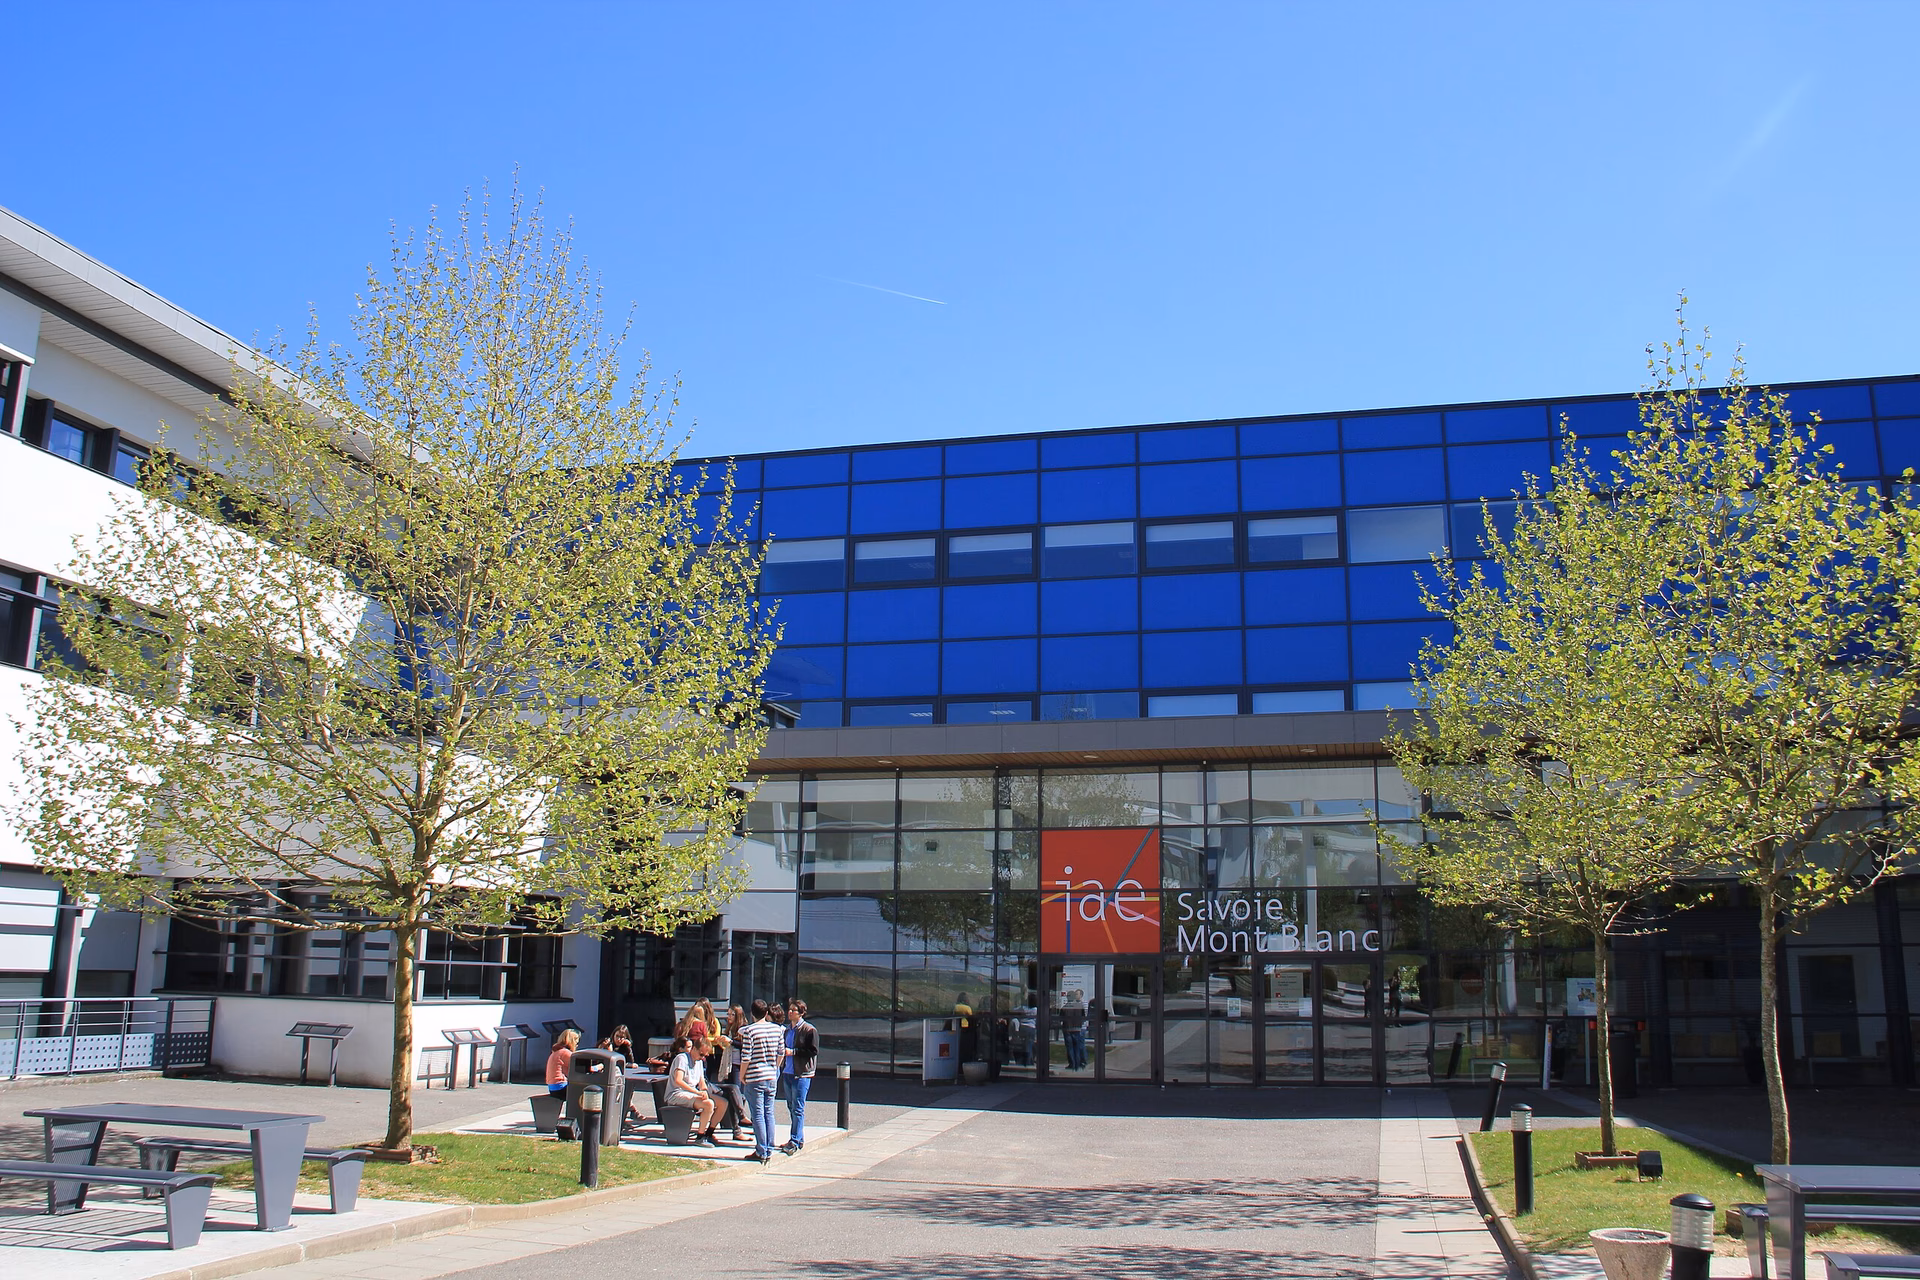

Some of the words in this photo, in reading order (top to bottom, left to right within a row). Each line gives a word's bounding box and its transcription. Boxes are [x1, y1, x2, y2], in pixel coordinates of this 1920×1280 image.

[1055, 865, 1146, 922] iae
[1176, 891, 1283, 921] Savoie
[1176, 924, 1270, 953] Mont
[1281, 923, 1380, 953] Blanc
